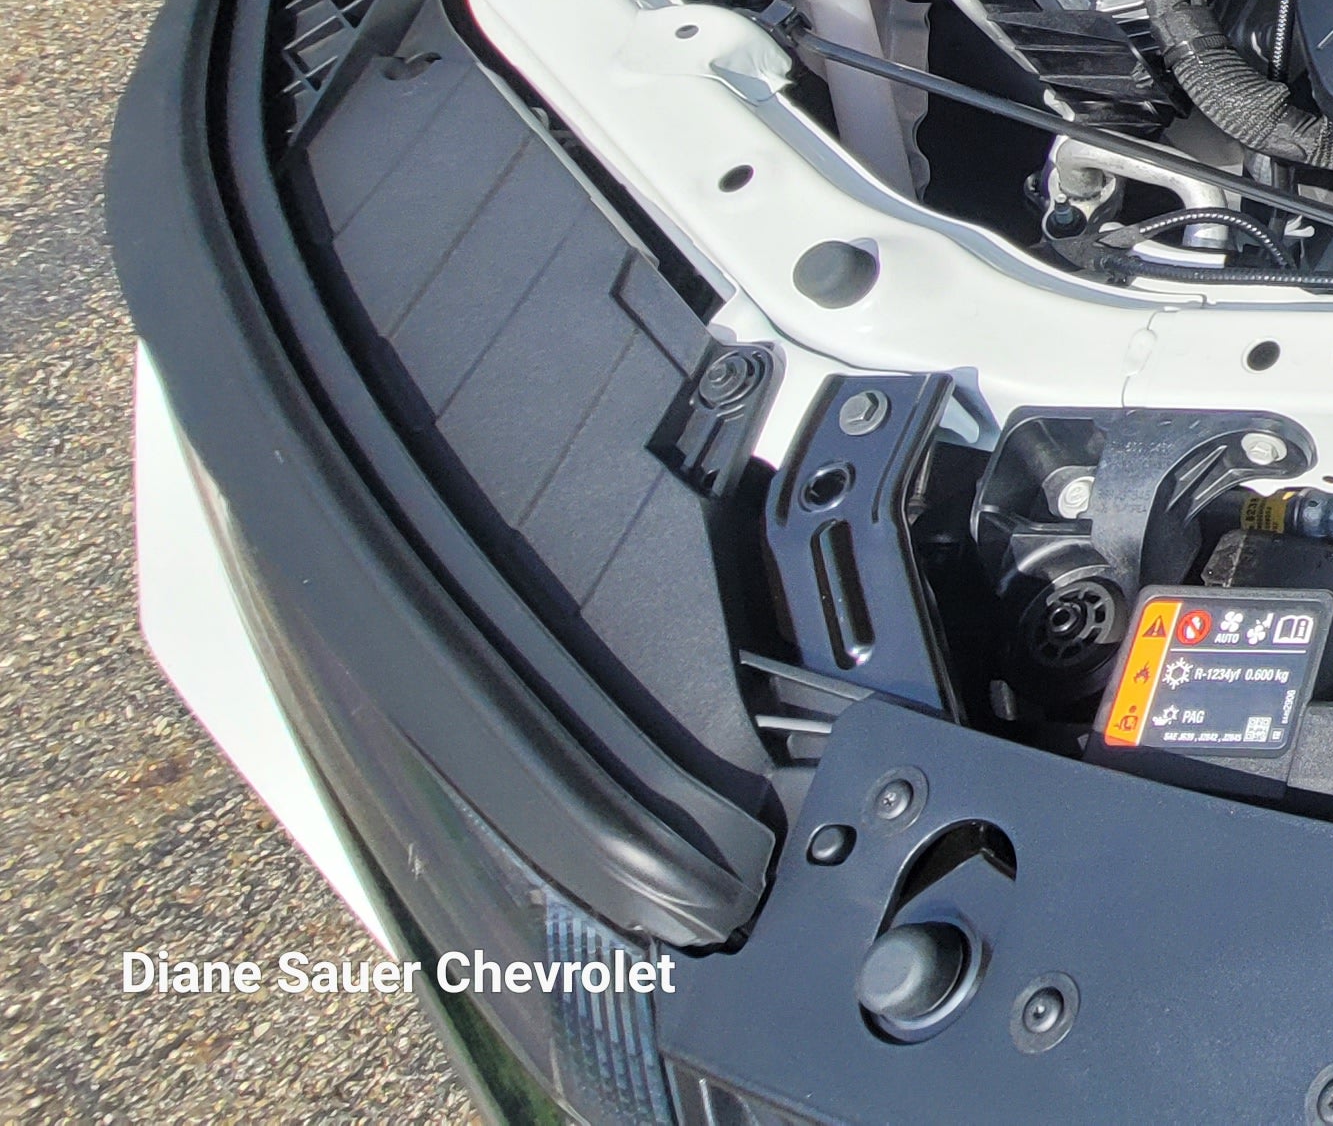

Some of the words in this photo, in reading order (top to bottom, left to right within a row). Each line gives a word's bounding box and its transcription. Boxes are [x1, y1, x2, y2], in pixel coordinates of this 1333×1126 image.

[1214, 633, 1240, 644] AUTO
[1194, 668, 1241, 683] R-1234yf
[1244, 668, 1274, 682] 0.600
[1274, 669, 1290, 684] kg
[1181, 710, 1206, 724] PAG
